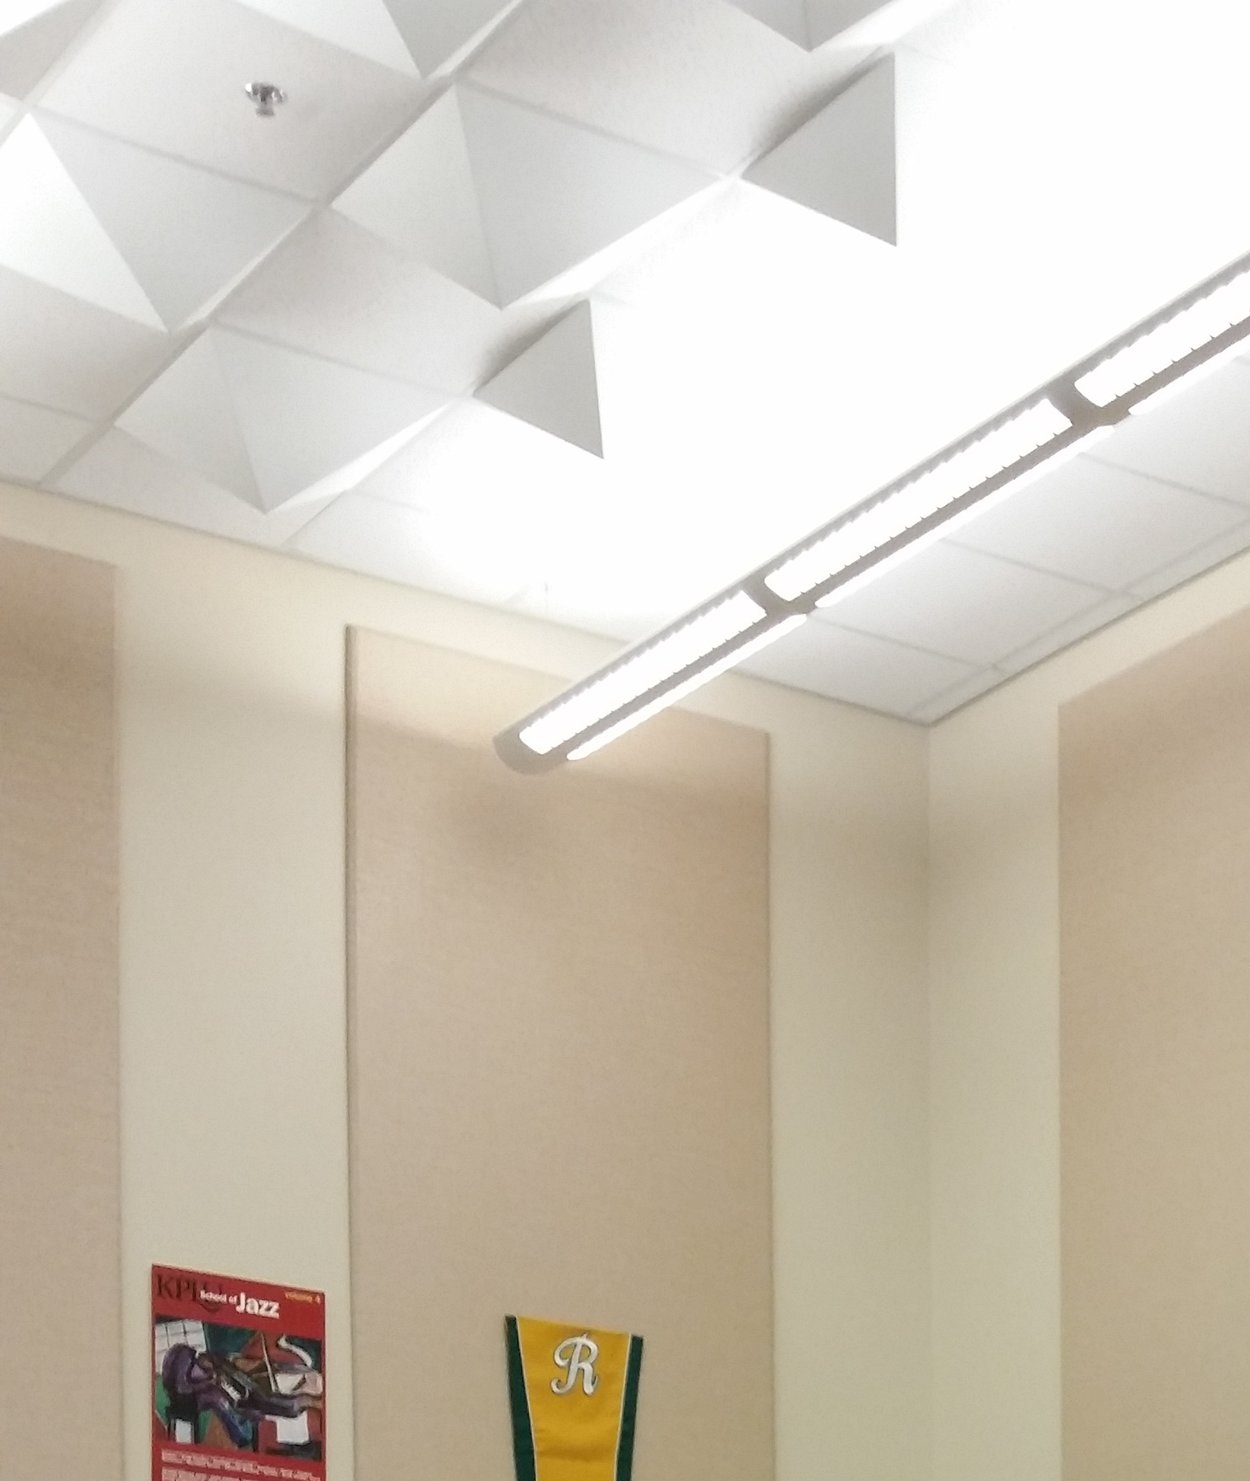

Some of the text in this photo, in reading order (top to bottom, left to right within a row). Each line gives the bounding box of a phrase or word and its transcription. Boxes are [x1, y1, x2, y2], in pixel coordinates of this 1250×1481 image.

[200, 1290, 280, 1319] School of Jazz
[551, 1333, 599, 1396] R
